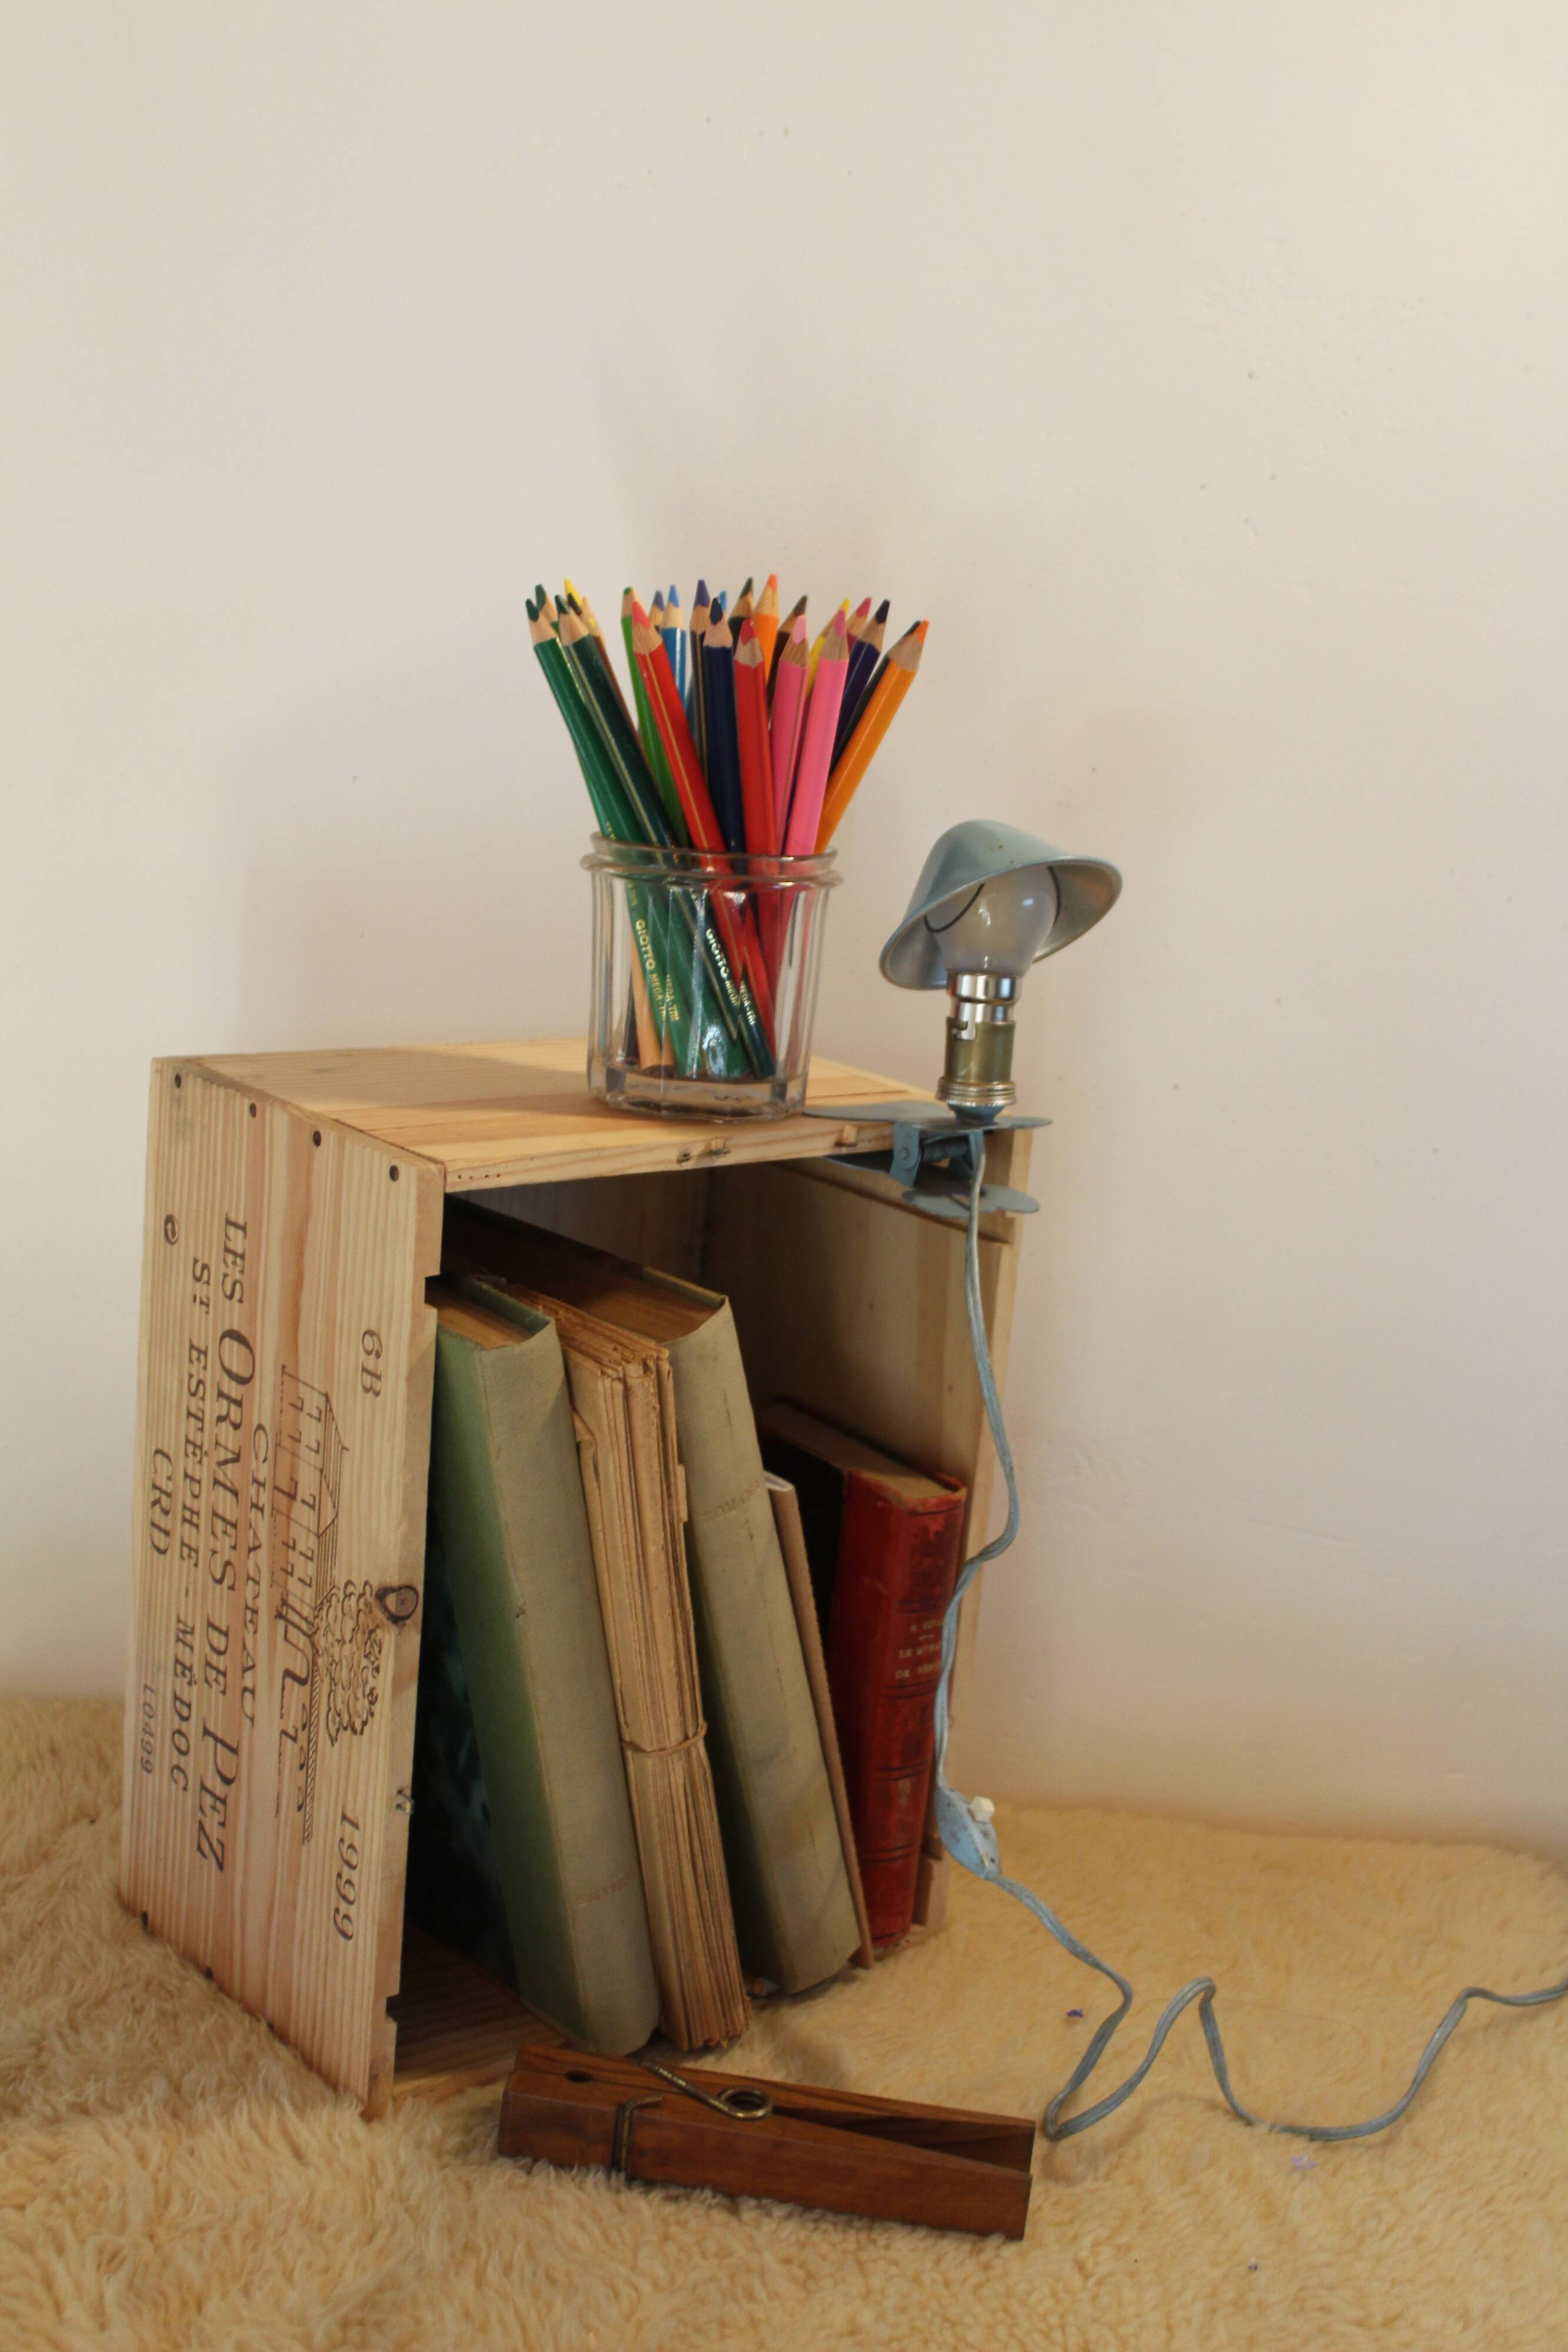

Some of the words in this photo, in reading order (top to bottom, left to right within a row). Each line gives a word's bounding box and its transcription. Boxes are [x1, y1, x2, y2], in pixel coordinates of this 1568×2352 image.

[636, 918, 656, 970] GIOTTO
[705, 927, 730, 978] GIOTTO
[221, 1211, 248, 1304] LES
[149, 1446, 173, 1556] CRD
[209, 1328, 256, 1592] ORMES
[241, 1423, 269, 1728] CHATEAU
[170, 1618, 198, 1791] MÉDOC
[203, 1613, 230, 1696] DE
[196, 1717, 240, 1873] PEZ
[333, 1805, 360, 1941] 1999
